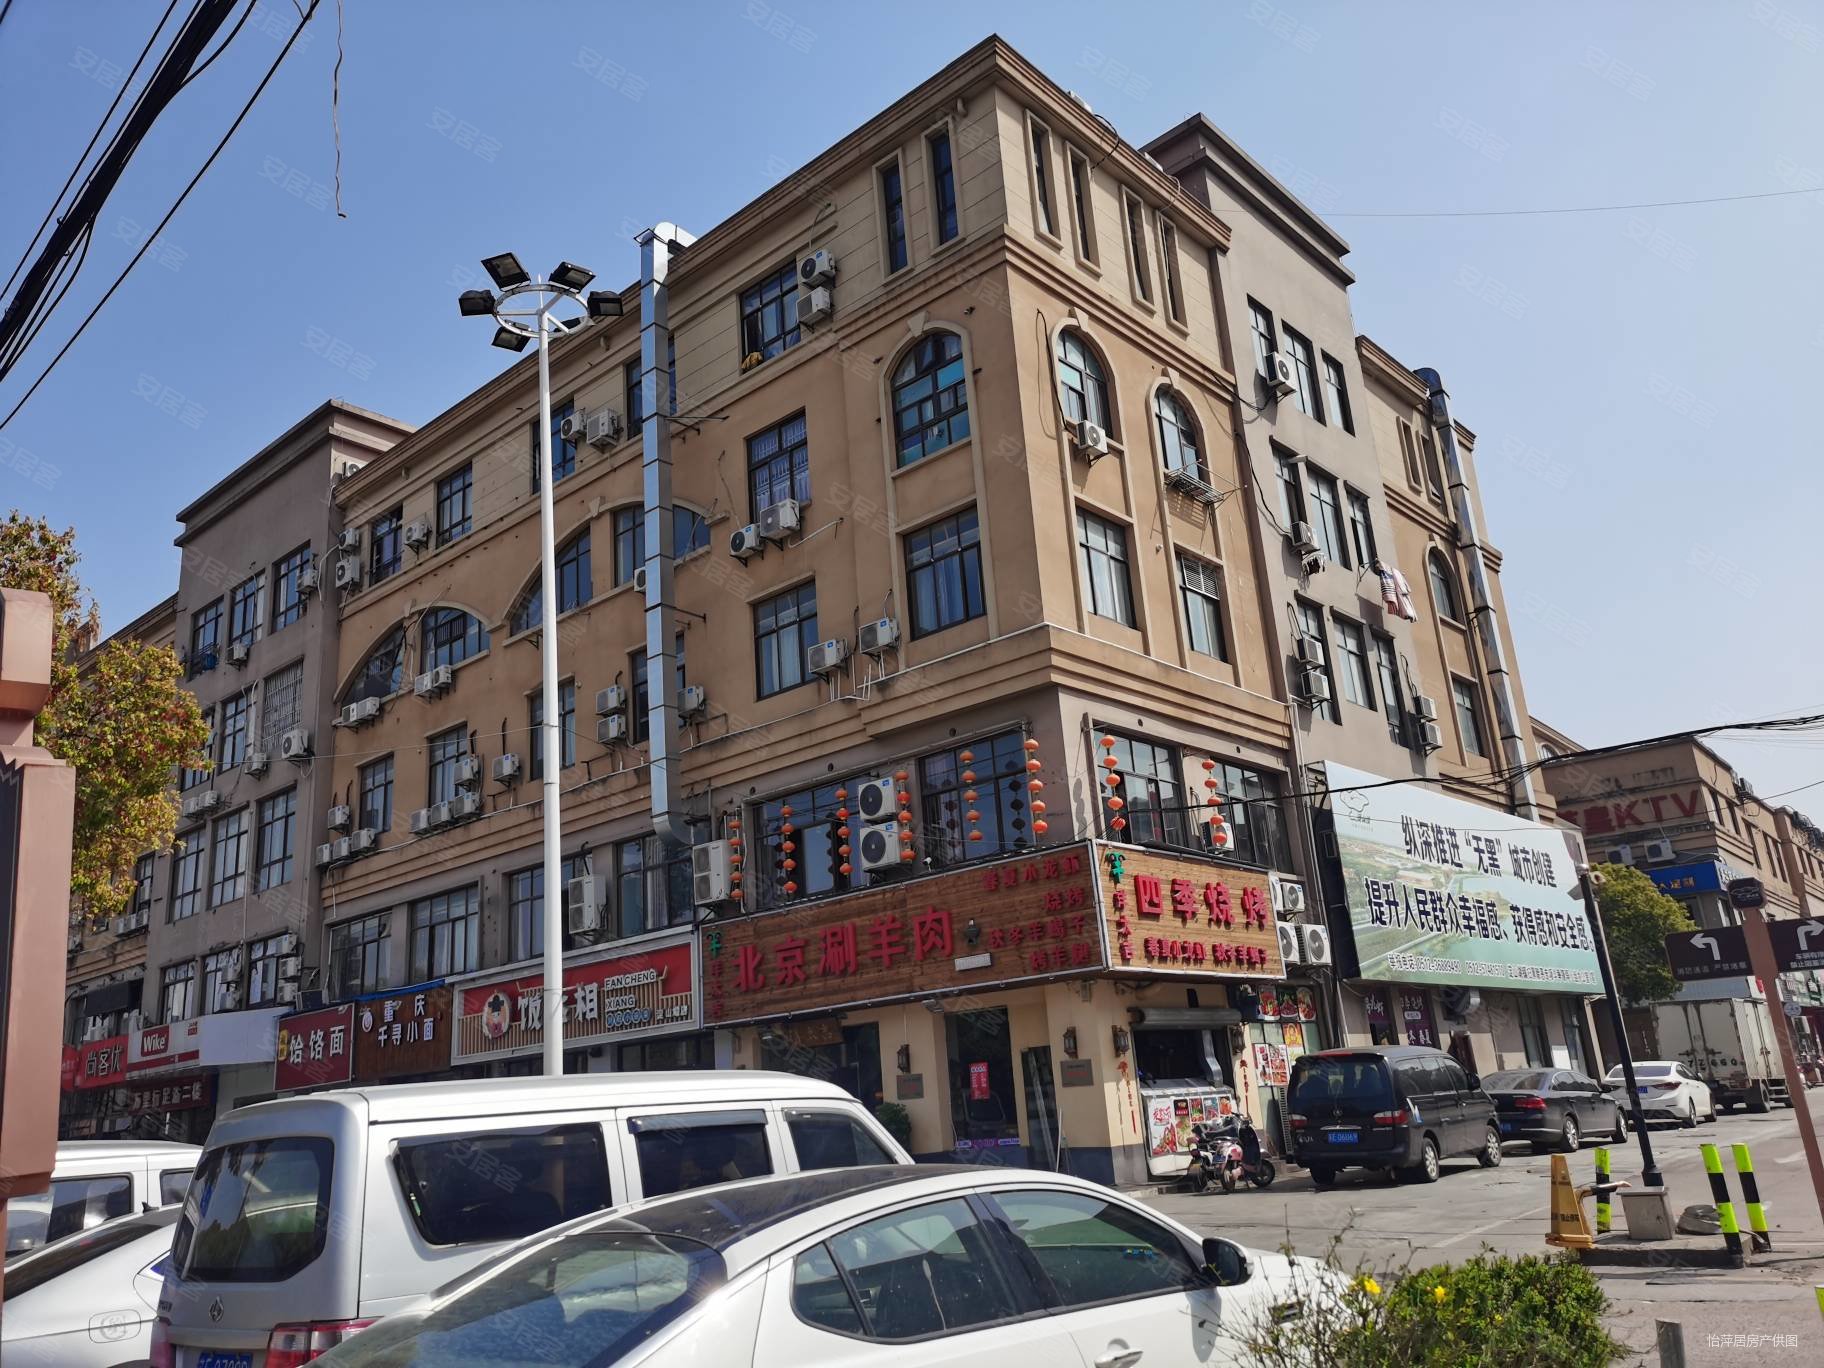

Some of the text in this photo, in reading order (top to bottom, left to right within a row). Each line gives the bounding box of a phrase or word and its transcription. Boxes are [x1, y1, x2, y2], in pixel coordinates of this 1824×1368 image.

[1134, 874, 1268, 925] 四季烧烤
[732, 905, 953, 993] 北京涮羊肉
[605, 971, 655, 989] FAN CHENG
[384, 994, 425, 1023] 重庆
[607, 996, 635, 1009] XIANG
[143, 1035, 166, 1052] Wike
[378, 1017, 434, 1048] 千寻小面
